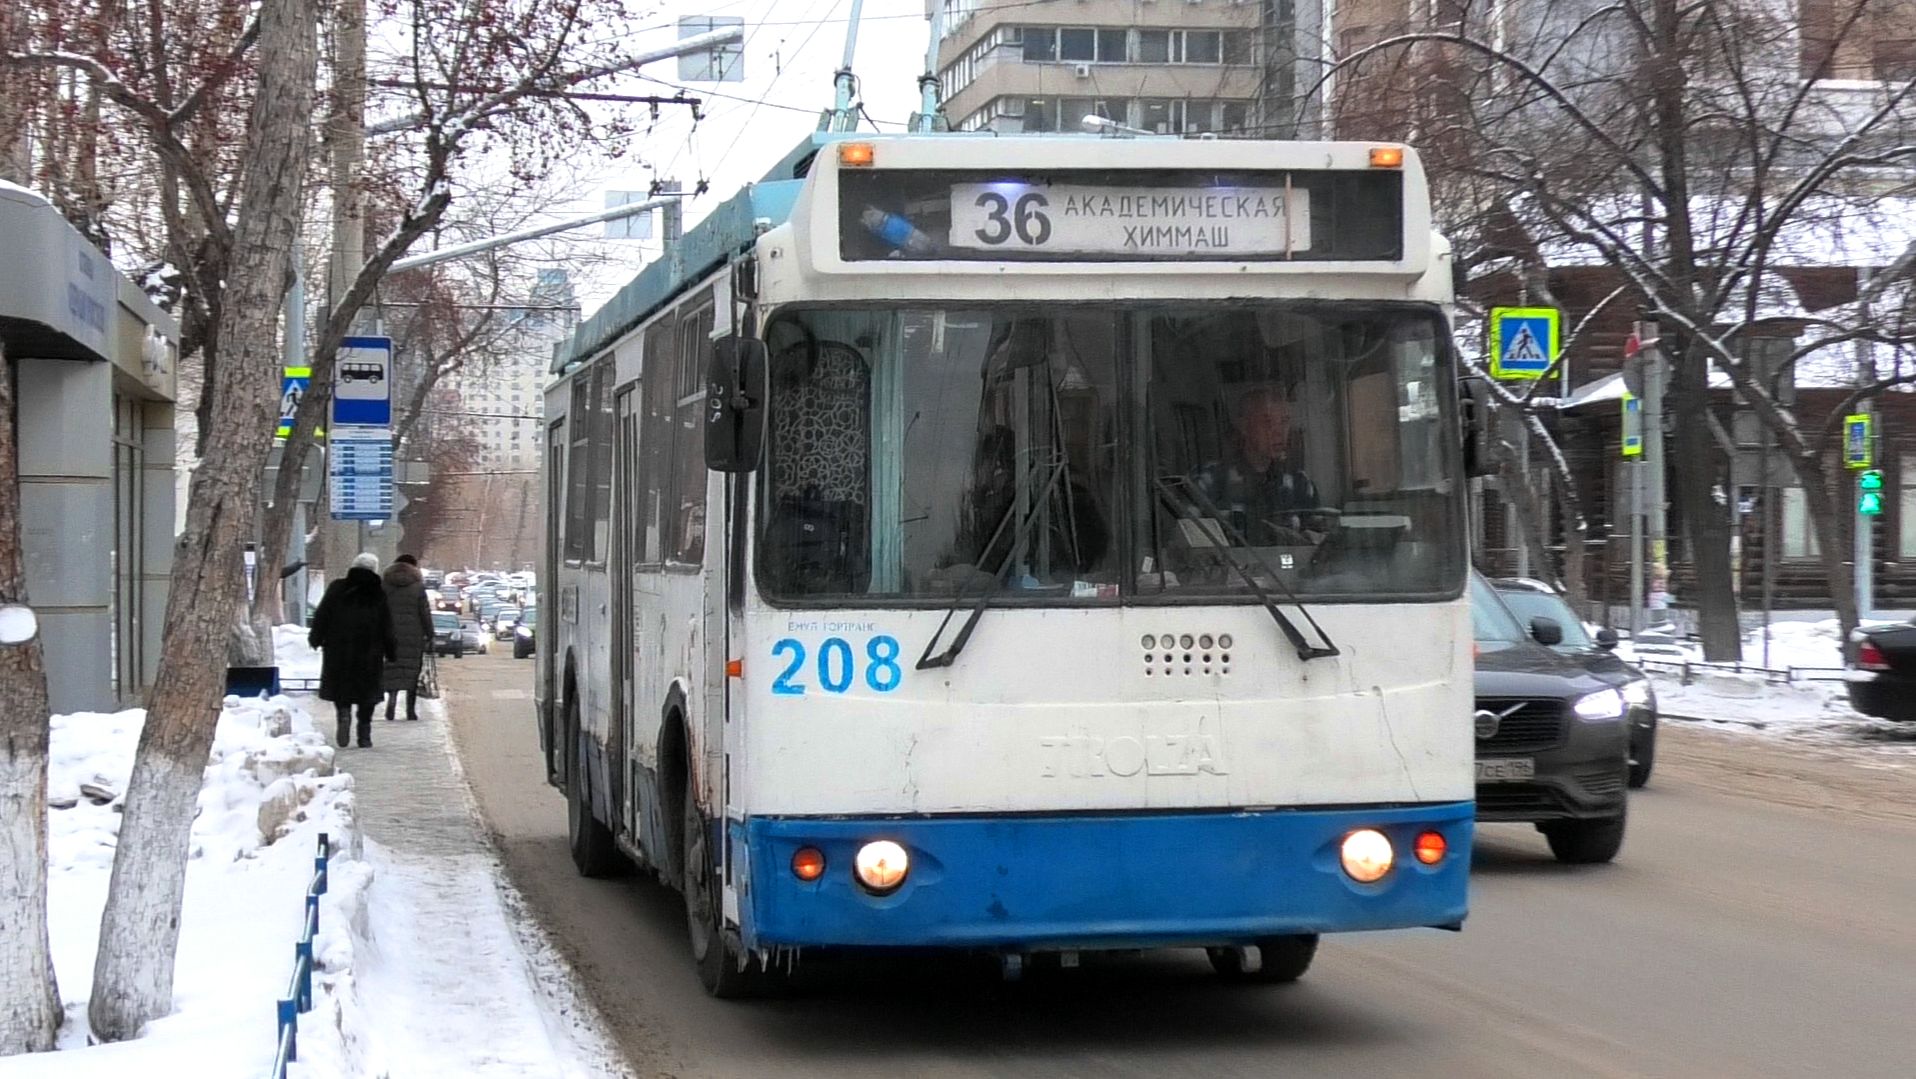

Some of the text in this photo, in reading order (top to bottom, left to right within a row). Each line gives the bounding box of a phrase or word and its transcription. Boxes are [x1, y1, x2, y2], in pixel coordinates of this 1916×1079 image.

[974, 191, 1052, 245] 36
[1064, 194, 1287, 219] АКАДЕМИЧЕСКАЯ
[1123, 225, 1229, 248] ХИММАШ
[771, 635, 902, 695] 208
